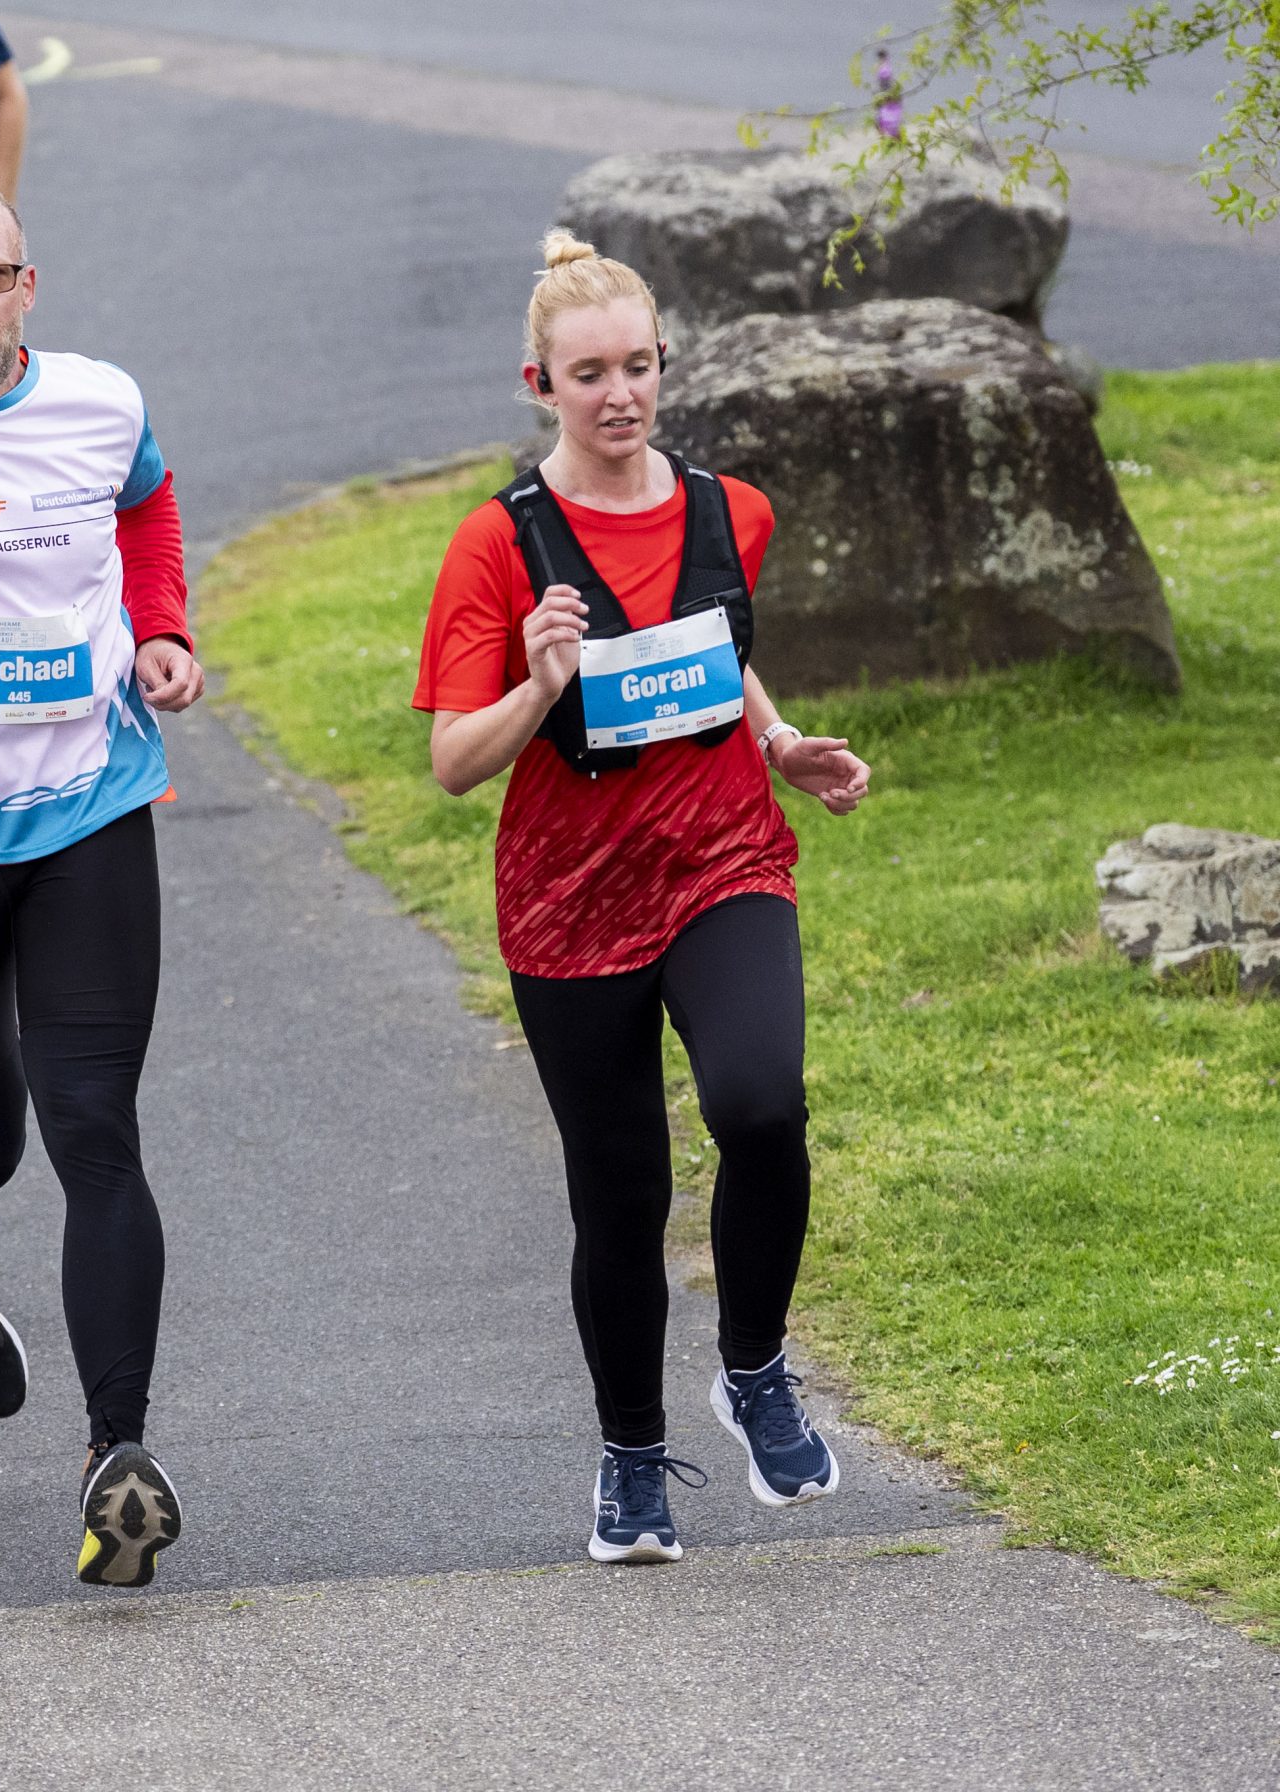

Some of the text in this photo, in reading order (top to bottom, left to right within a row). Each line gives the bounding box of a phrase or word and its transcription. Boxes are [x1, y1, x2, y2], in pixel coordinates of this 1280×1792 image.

[621, 664, 706, 702] Goran
[7, 691, 31, 703] 445
[655, 702, 679, 718] 290
